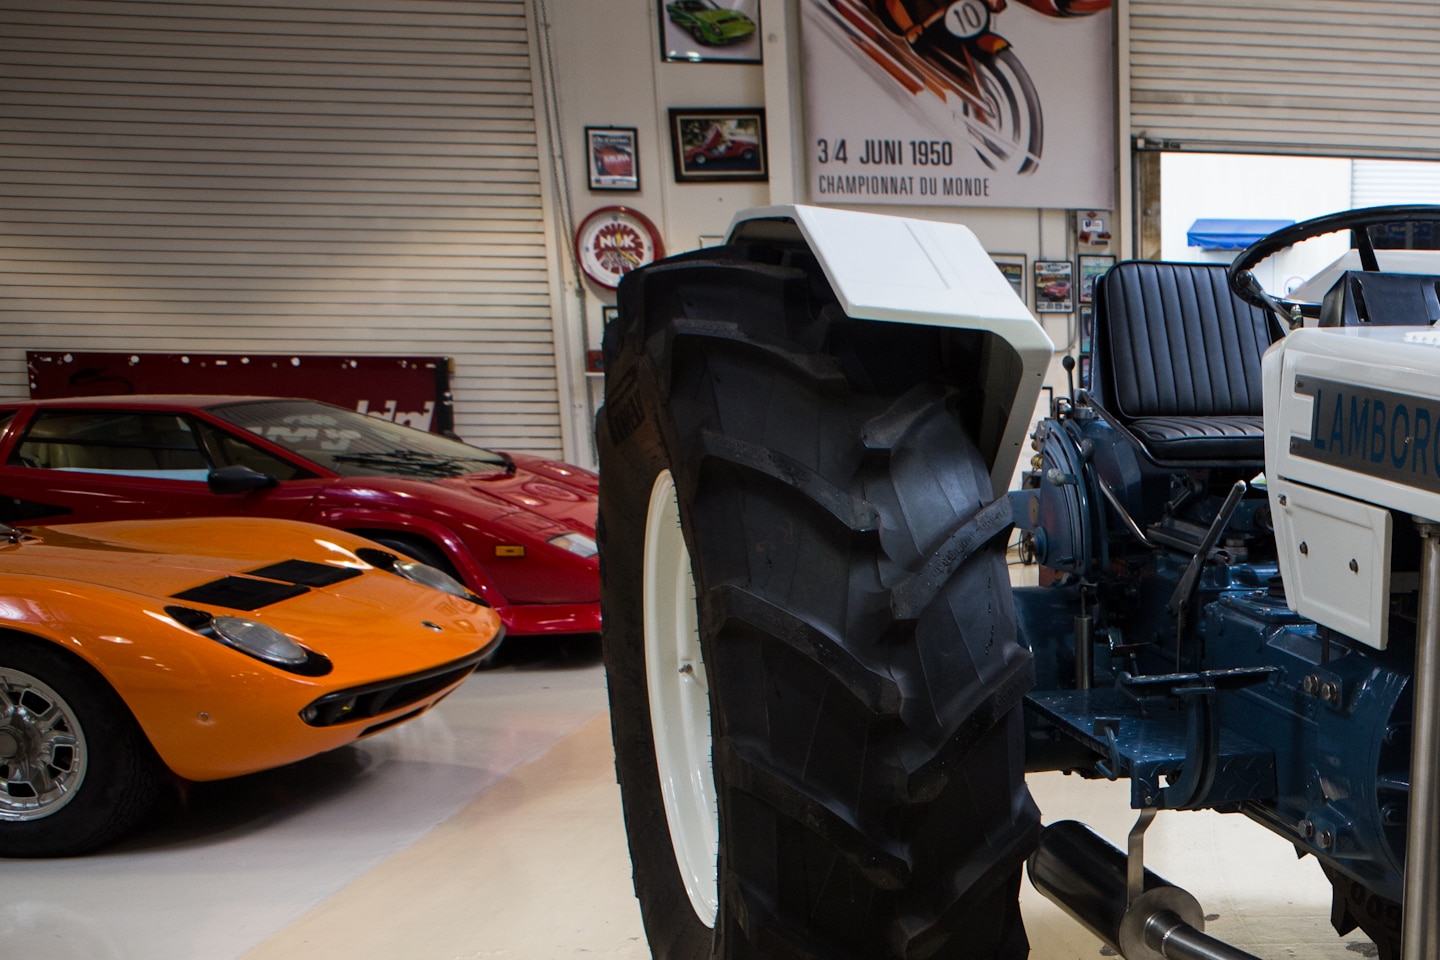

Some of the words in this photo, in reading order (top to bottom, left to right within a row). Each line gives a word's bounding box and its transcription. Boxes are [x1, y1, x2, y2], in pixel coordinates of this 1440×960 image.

[953, 2, 982, 35] 10
[859, 139, 903, 165] JUNI
[909, 140, 953, 166] 1950
[818, 175, 914, 195] CHAMPIONNAT
[920, 176, 937, 195] DU
[943, 178, 990, 197] MONDE
